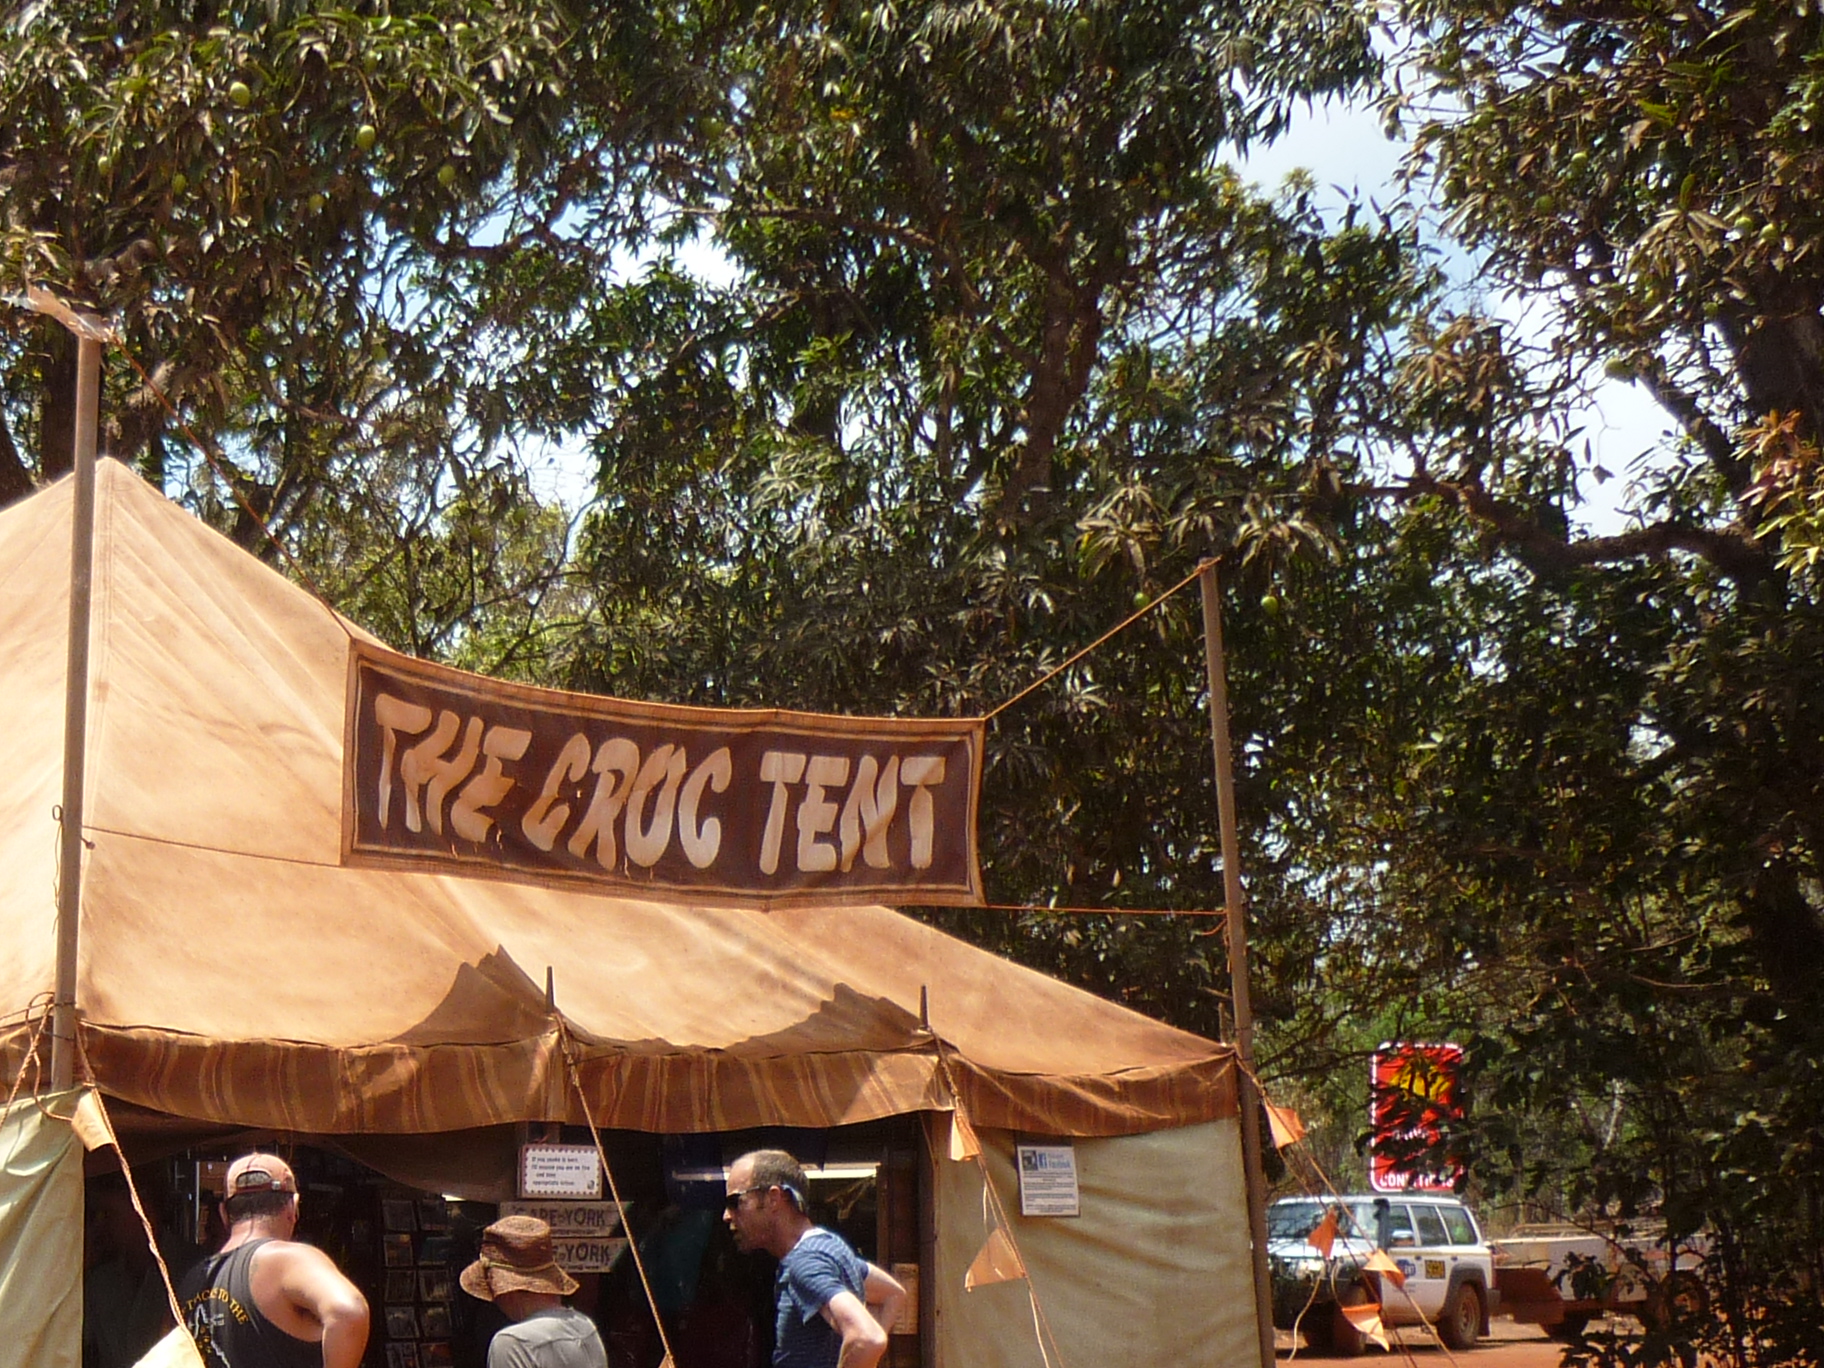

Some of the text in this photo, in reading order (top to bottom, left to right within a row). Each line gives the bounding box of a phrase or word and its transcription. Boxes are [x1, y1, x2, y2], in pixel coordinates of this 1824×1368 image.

[376, 694, 946, 875] THE CROC TENT
[565, 1207, 605, 1226] YORK
[565, 1242, 610, 1265] YORK
